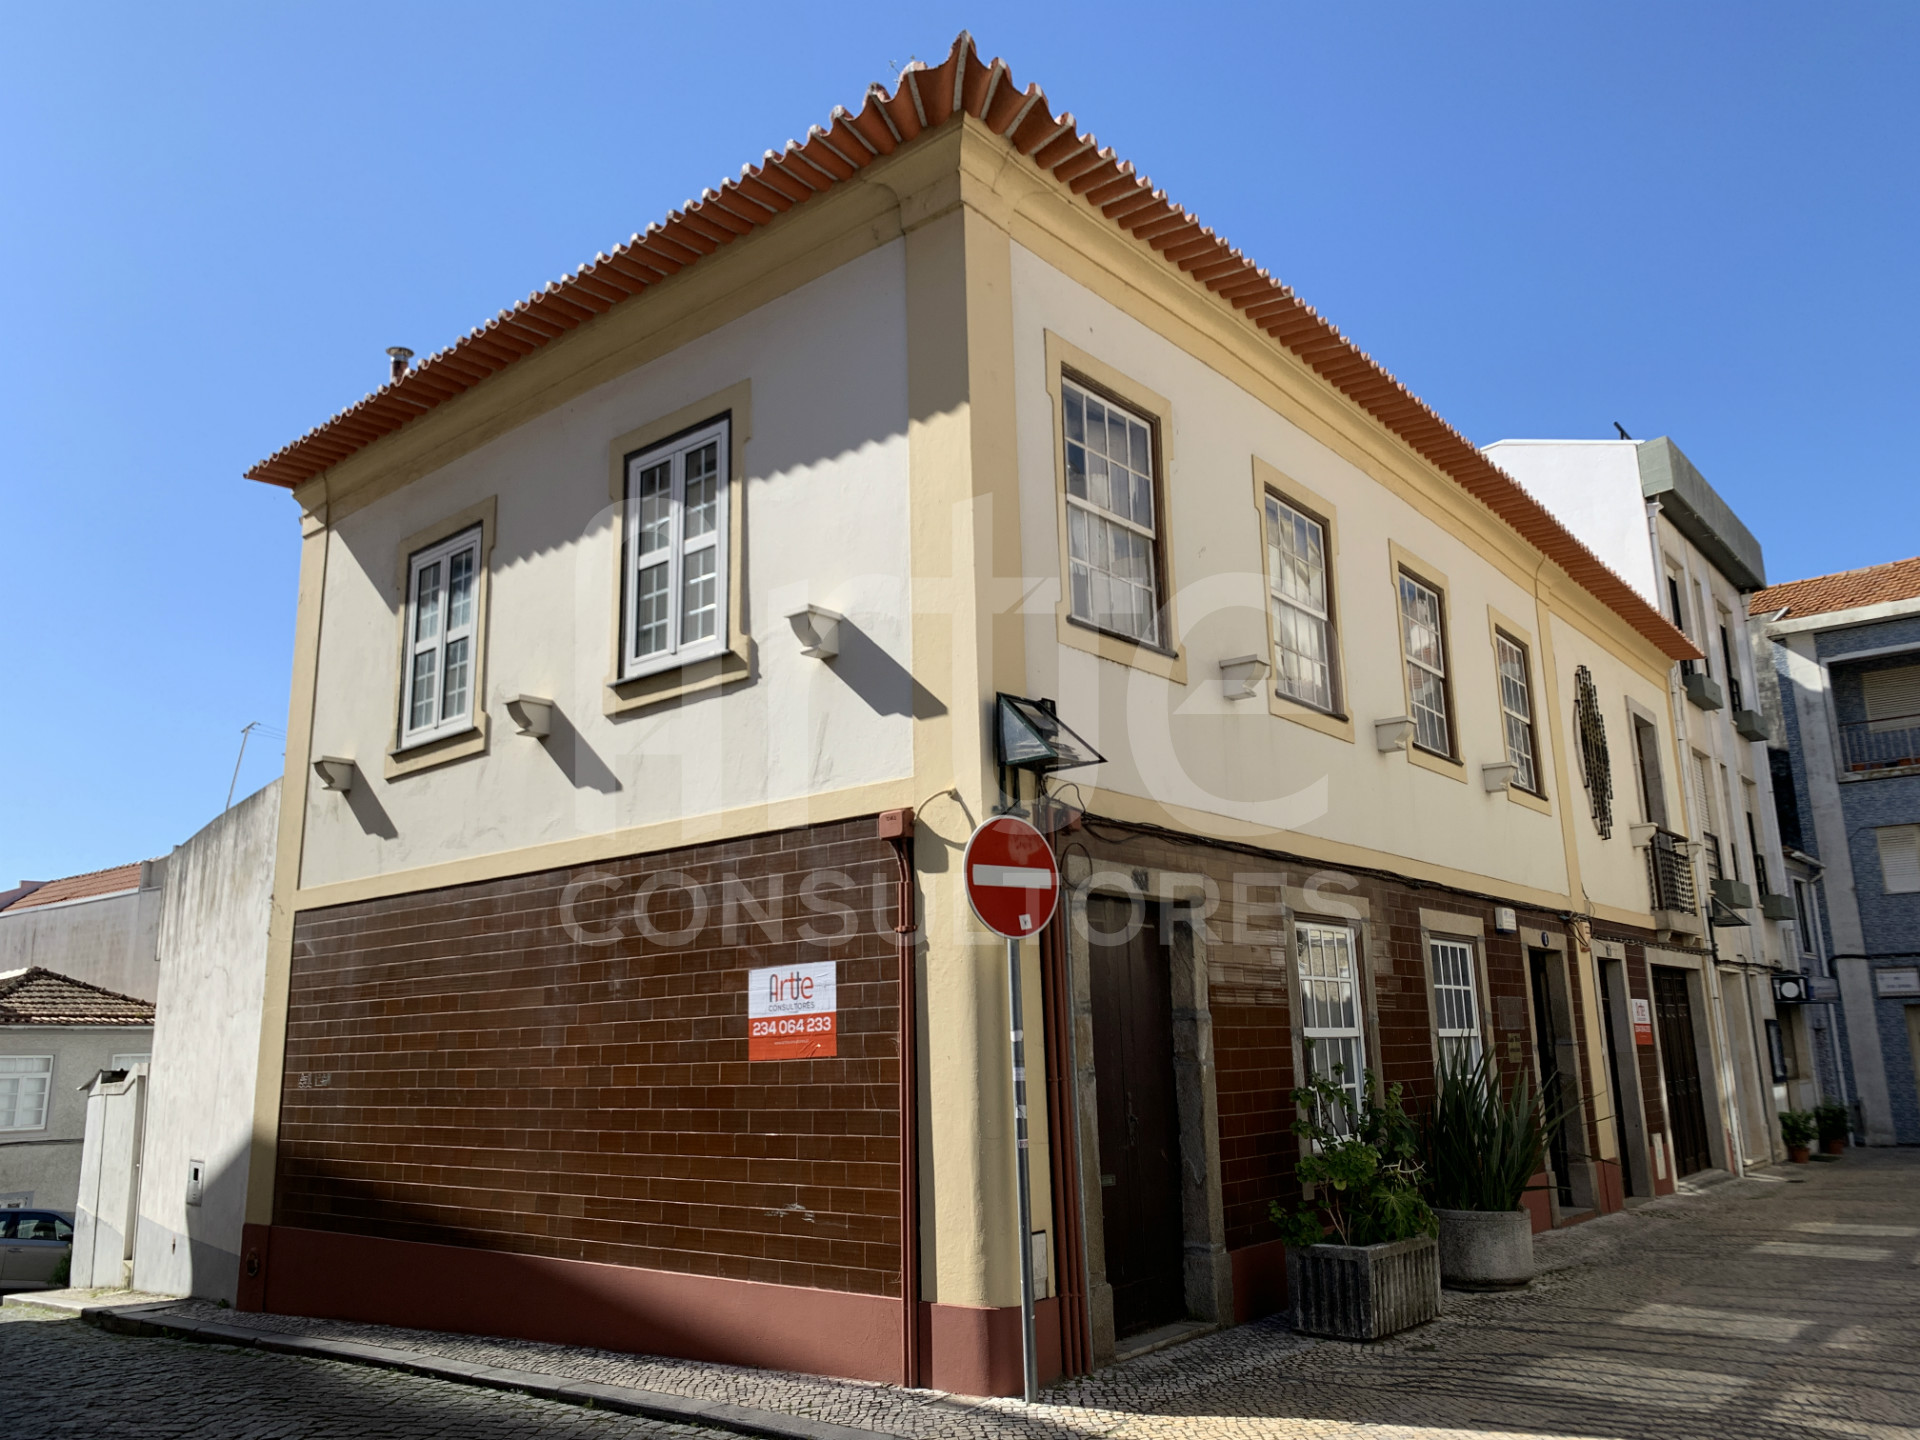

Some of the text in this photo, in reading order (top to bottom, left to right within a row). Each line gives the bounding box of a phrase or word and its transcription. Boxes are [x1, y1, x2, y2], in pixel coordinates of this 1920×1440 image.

[768, 1001, 816, 1012] CONSULTORES
[752, 1016, 832, 1036] 234 064 233
